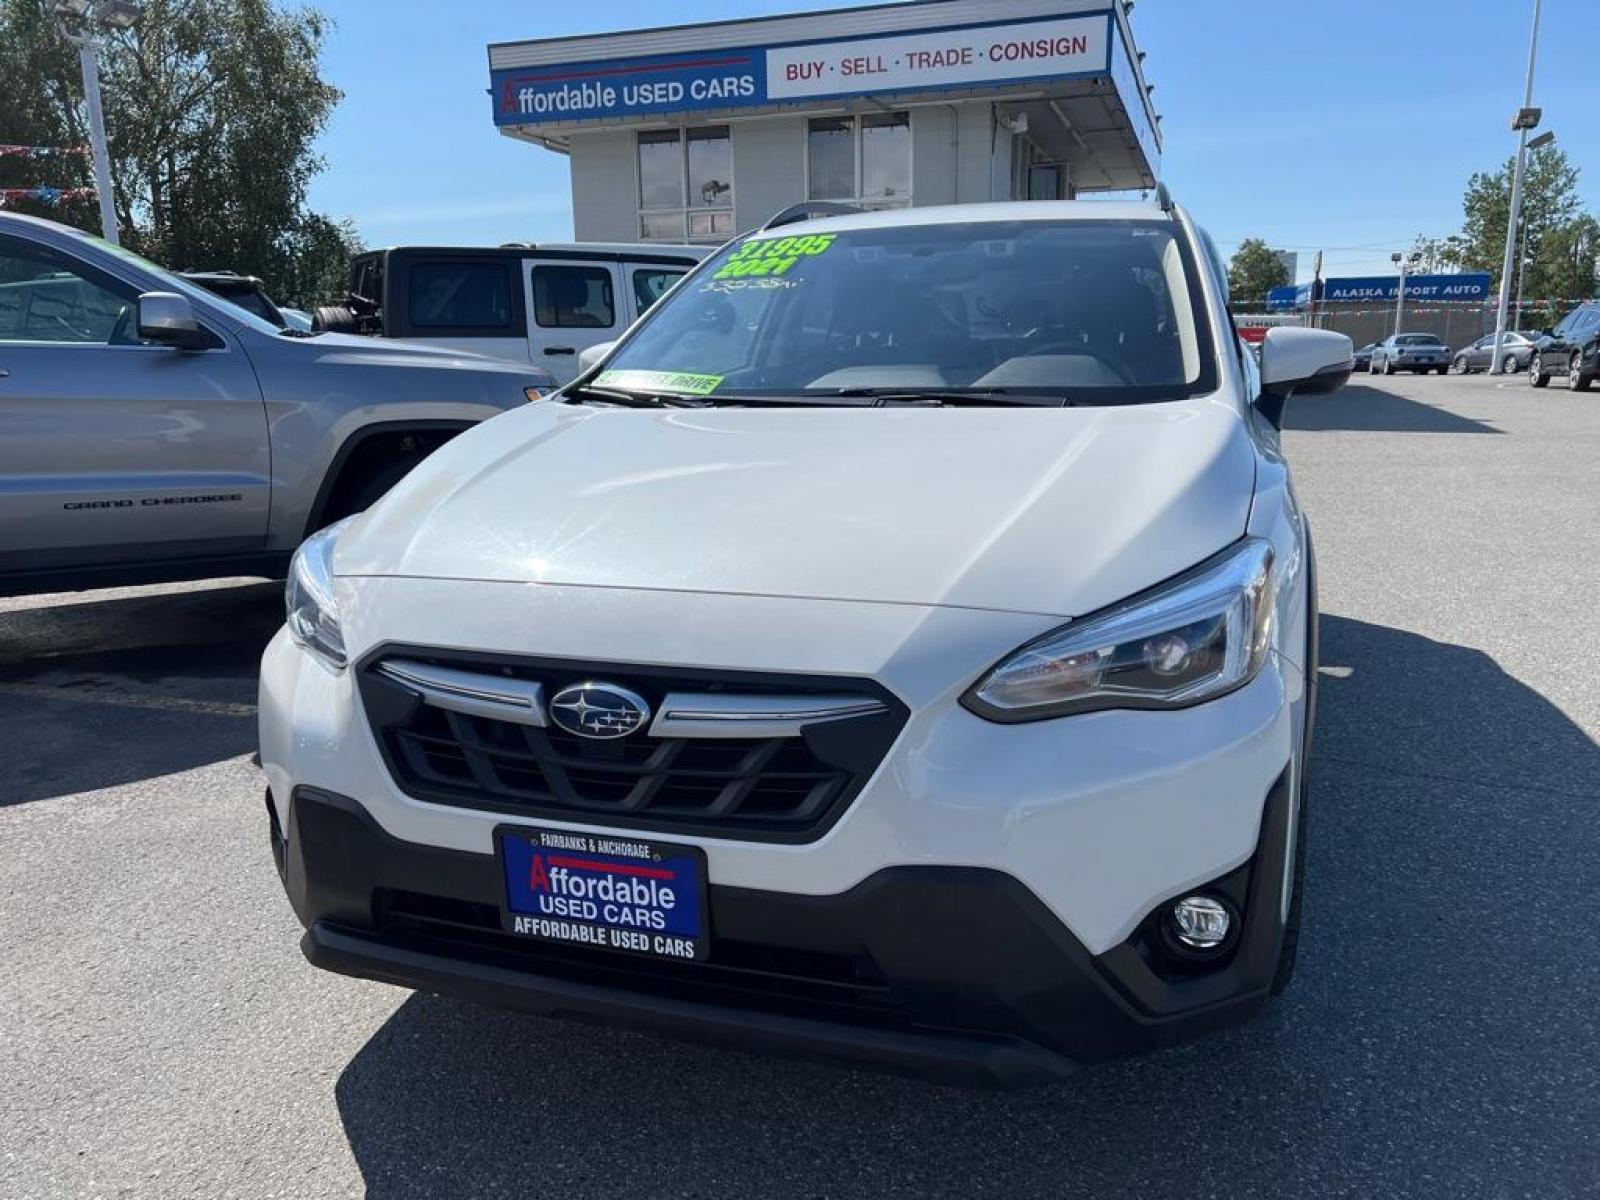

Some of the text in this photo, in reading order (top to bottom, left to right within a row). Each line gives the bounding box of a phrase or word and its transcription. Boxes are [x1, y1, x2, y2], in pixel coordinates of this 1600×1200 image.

[786, 35, 1087, 81] BUY SELL TRADE CONSIGN
[502, 75, 755, 113] Affordable USED CARS
[728, 233, 838, 262] 31995
[1332, 288, 1383, 297] ALASKA
[1443, 285, 1481, 295] AUTO
[63, 494, 242, 510] GRAND CHEROKEE
[540, 833, 651, 859] FAIRBANKS & ANCHORAGE
[530, 853, 676, 909] Affordable
[539, 895, 666, 930] USED CARS
[514, 917, 695, 959] AFFORDABLE USED CARS
